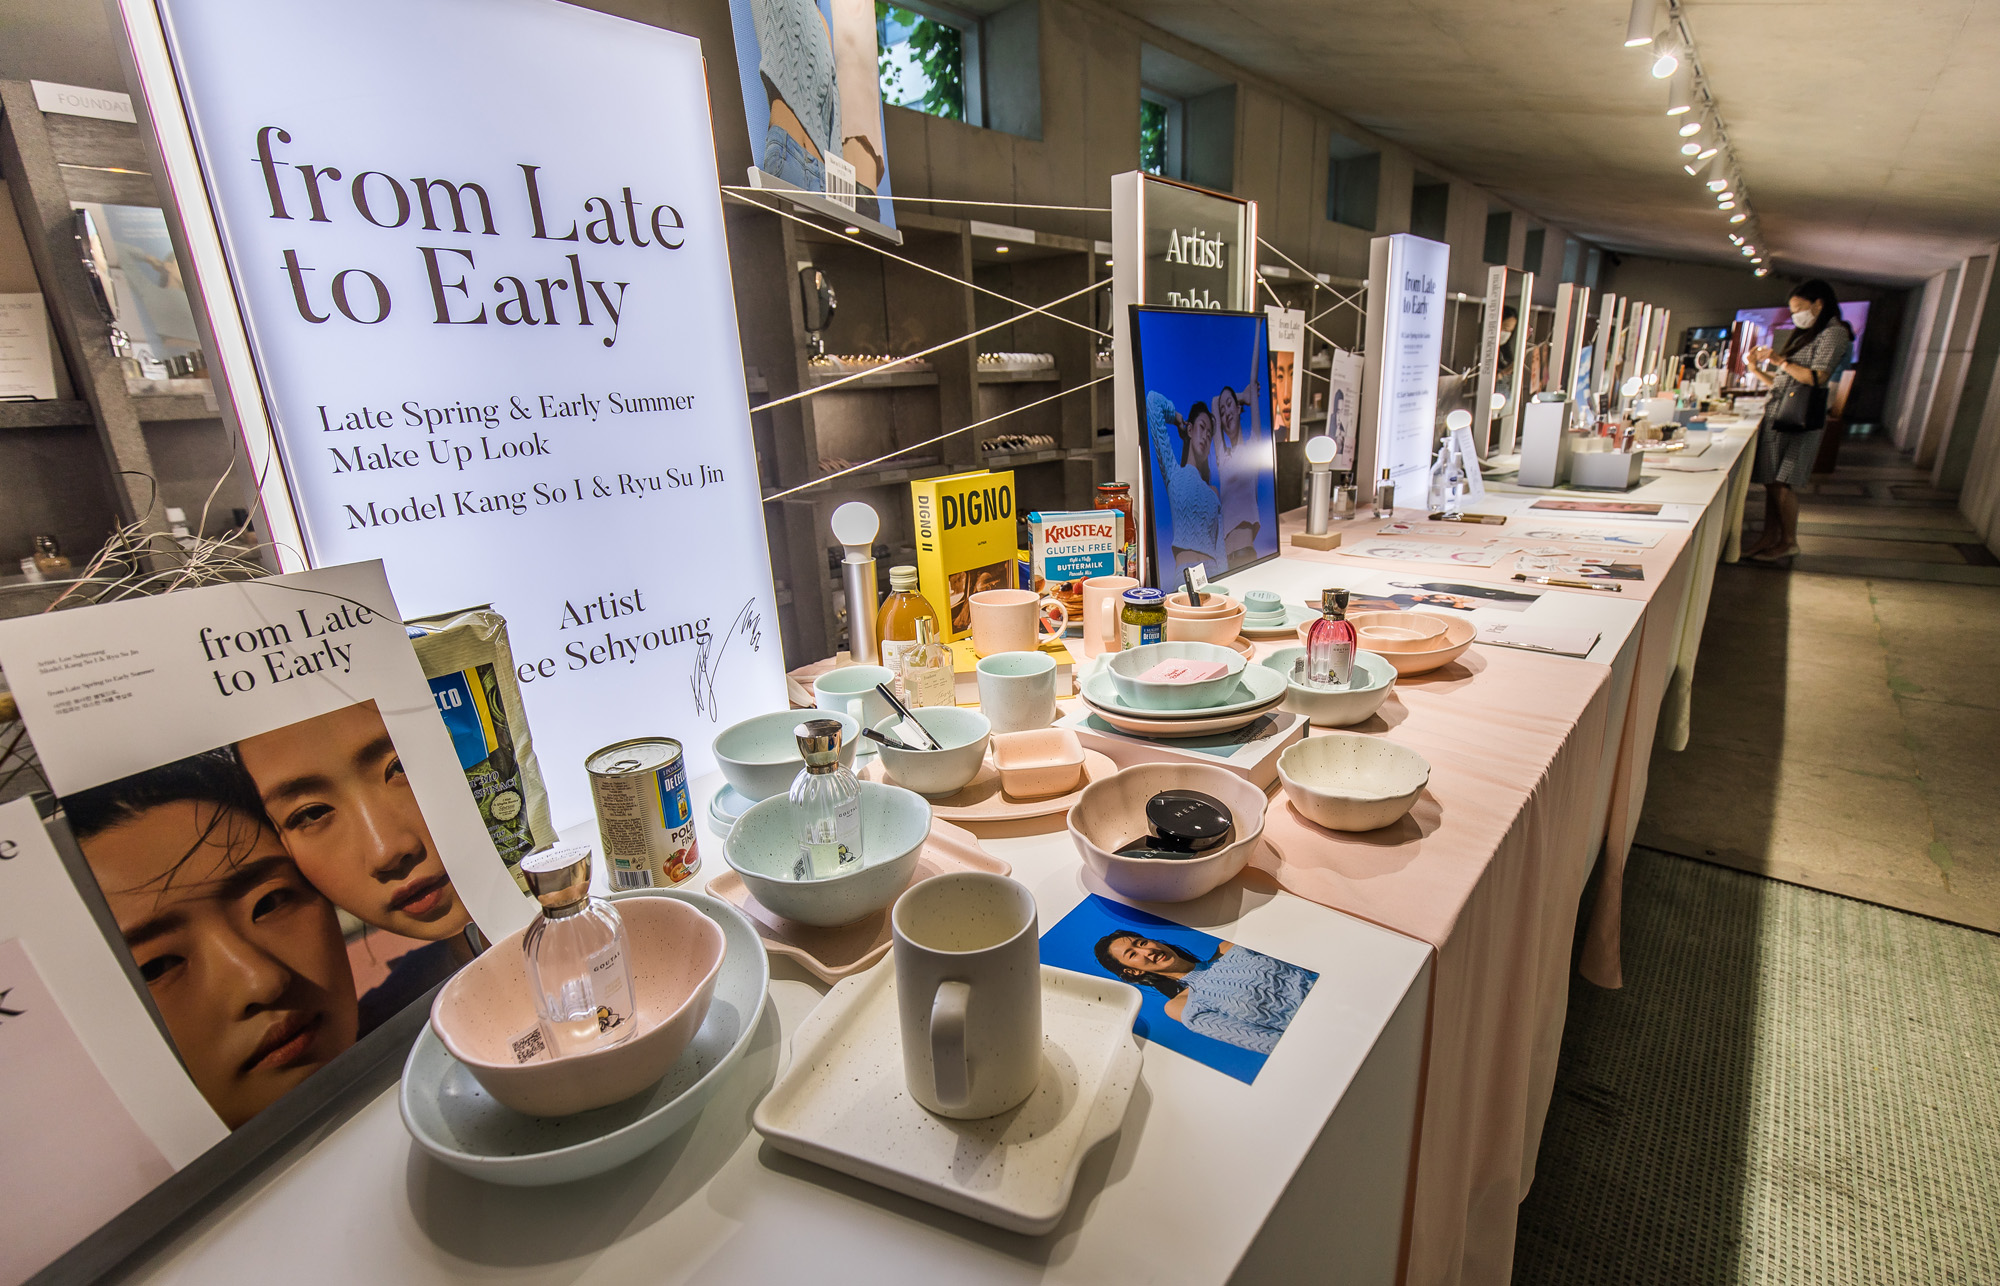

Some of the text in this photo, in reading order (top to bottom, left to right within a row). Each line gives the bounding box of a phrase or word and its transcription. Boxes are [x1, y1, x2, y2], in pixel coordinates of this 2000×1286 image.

[251, 126, 684, 250] from Late
[1165, 227, 1224, 269] Artist
[280, 247, 630, 348] to Early
[1405, 270, 1437, 294] from Late
[1403, 295, 1430, 320] to Early
[317, 391, 695, 434] Late Spring & Early Summer
[328, 432, 551, 474] Make Up Look
[343, 464, 725, 530] Model Kang So I & Ryu Su Jin
[942, 485, 1012, 531] DIGNO
[918, 495, 933, 552] DIGNO II
[1045, 524, 1113, 544] KRUSTEAZ
[1046, 543, 1112, 555] GLUTEN FREE
[1057, 562, 1103, 571] BUTTERMILK
[559, 588, 647, 631] Artist
[199, 604, 373, 662] from Late
[516, 616, 712, 684] ee Sehyoung
[213, 638, 352, 697] to Early
[473, 777, 516, 799] SPINACI
[664, 777, 675, 792] DE
[1174, 802, 1204, 818] HERA
